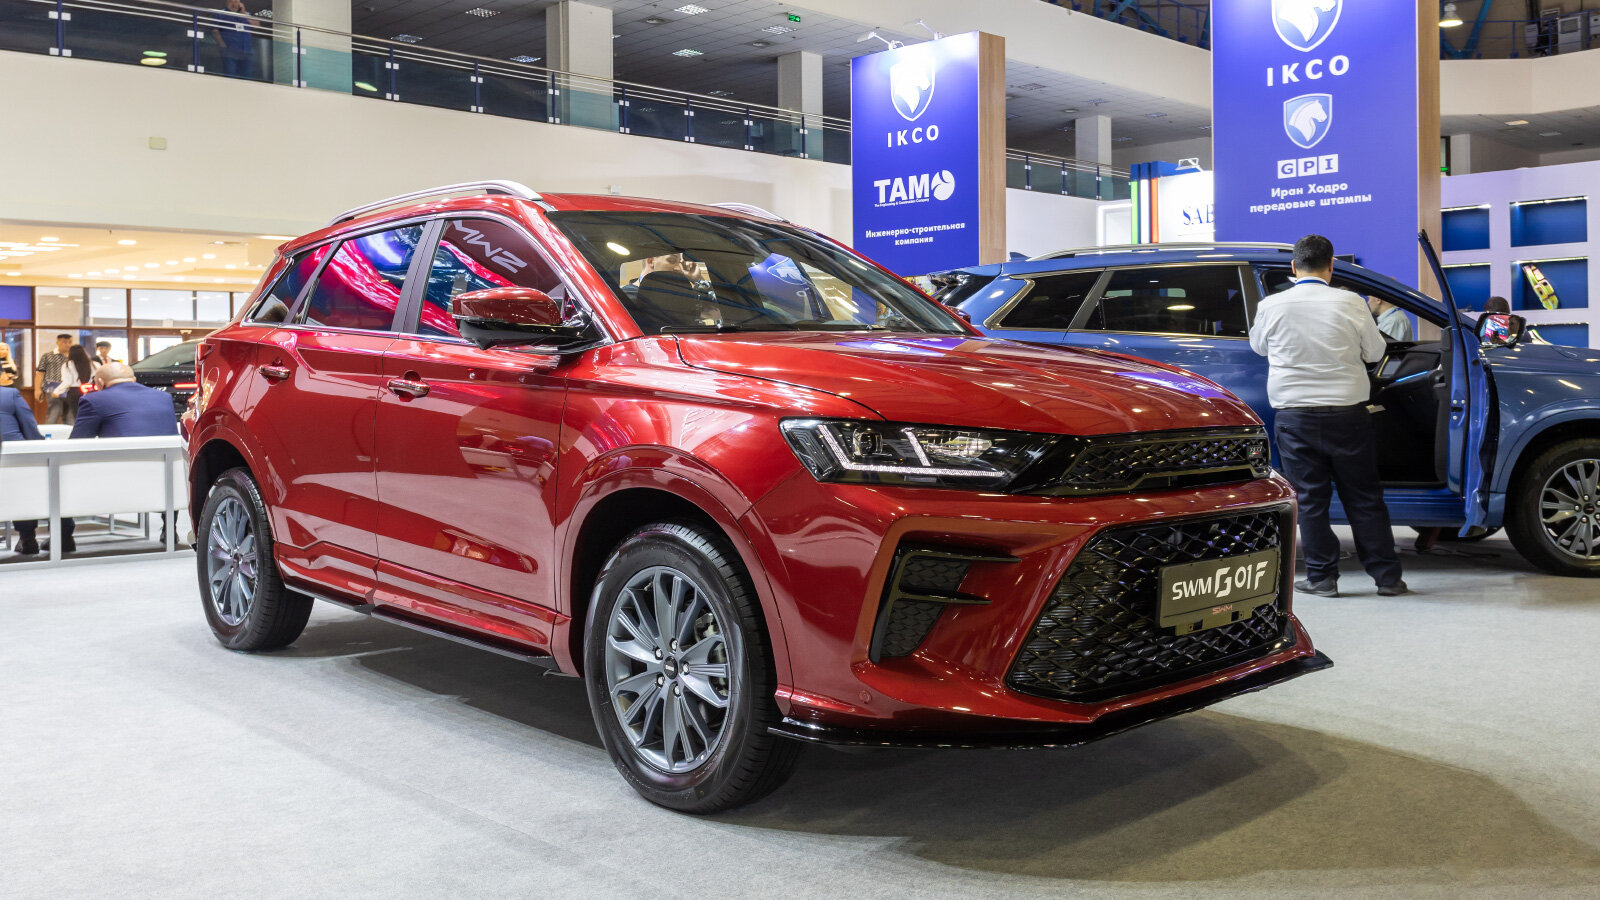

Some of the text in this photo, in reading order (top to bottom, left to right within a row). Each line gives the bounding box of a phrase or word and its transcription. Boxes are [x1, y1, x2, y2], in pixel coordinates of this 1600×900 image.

[1266, 55, 1350, 87] IKCO
[887, 125, 939, 147] IKCO
[1279, 156, 1336, 177] GPI
[1271, 182, 1348, 199] Иран Ходро
[1249, 194, 1372, 215] передовые штампы
[865, 222, 966, 238] Инженерно-строительная
[894, 236, 934, 246] компания
[1171, 576, 1212, 601] SWM
[1211, 604, 1233, 615] SWM
